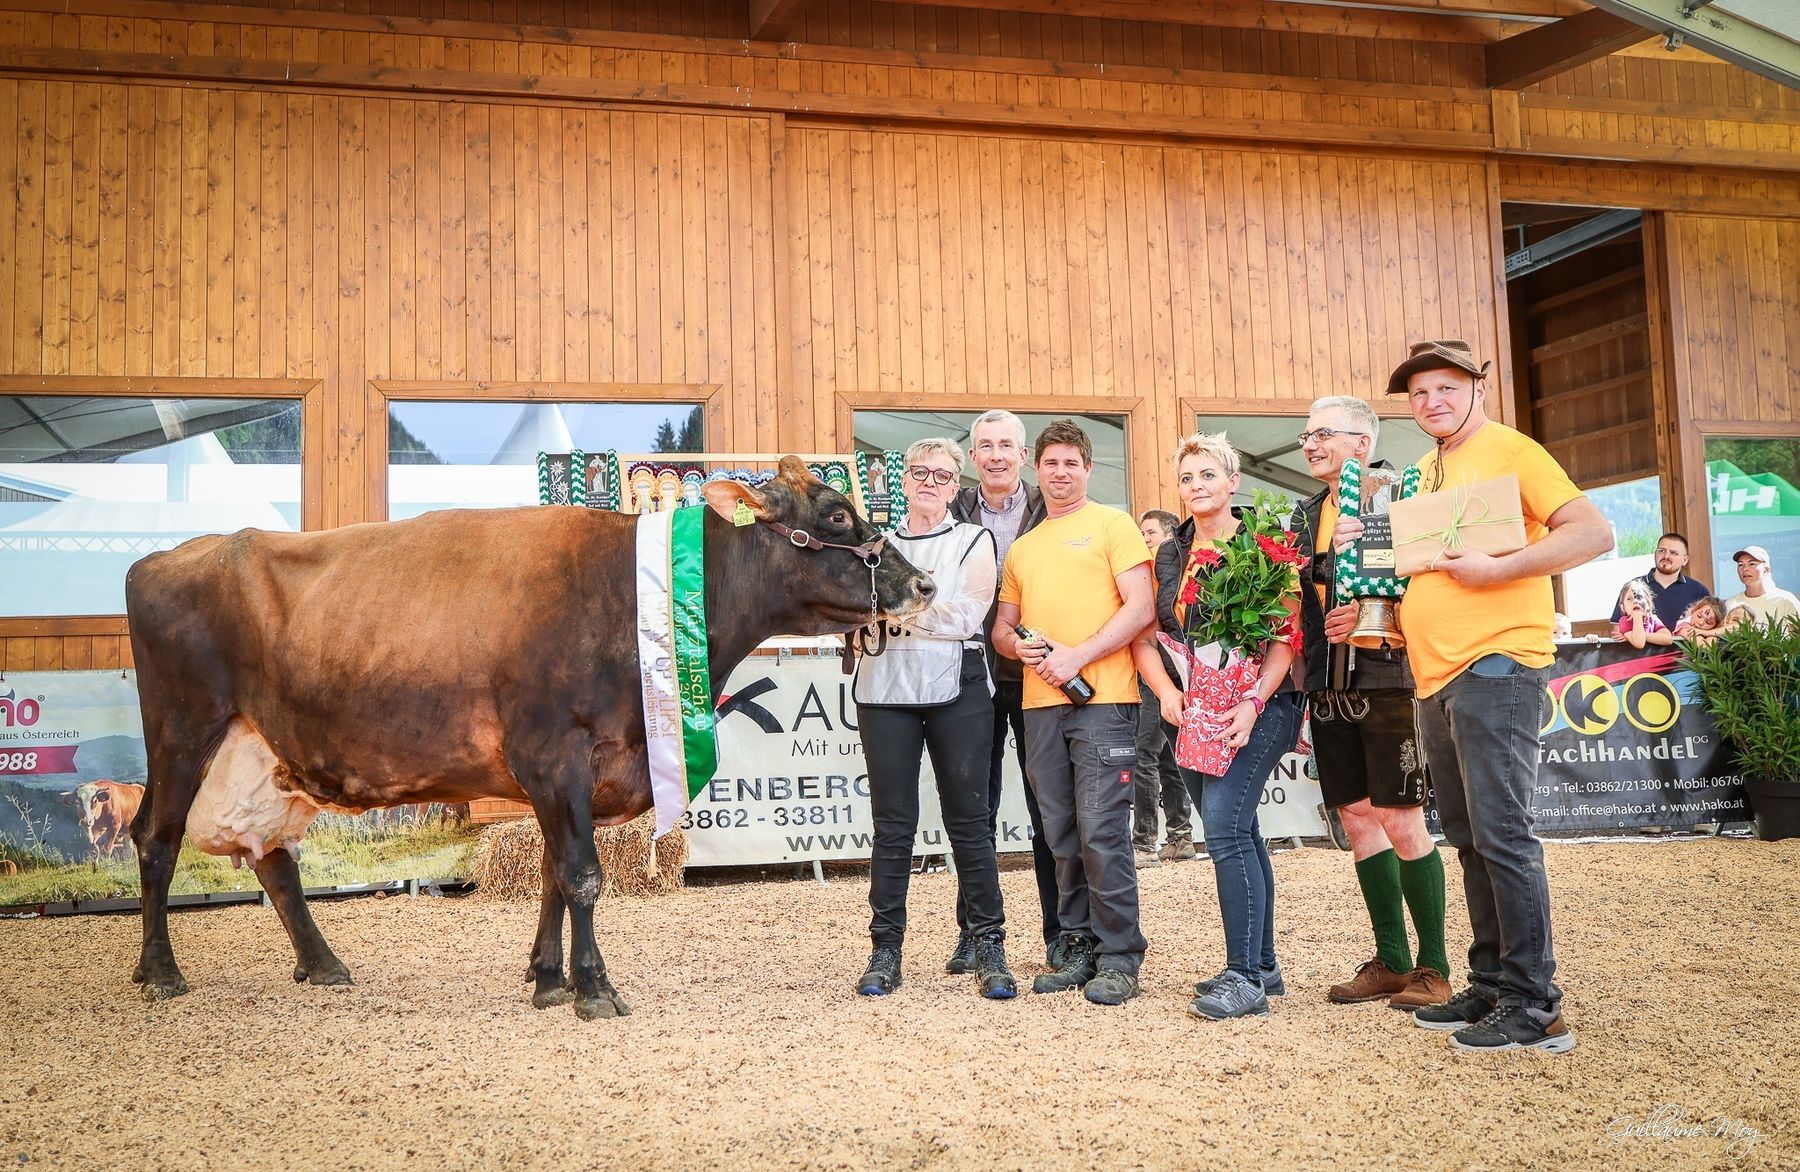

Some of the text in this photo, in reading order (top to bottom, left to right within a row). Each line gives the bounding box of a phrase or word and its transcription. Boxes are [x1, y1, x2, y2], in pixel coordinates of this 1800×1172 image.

[22, 729, 80, 740] Österreich
[791, 738, 829, 757] Mit
[1562, 782, 1584, 794] Tel.:
[1586, 779, 1662, 794] 03862/21300
[1673, 777, 1709, 790] Mobil:
[773, 804, 853, 827] 33811
[1571, 803, 1656, 817] office@hako.at
[1670, 798, 1744, 813] www.hako.at
